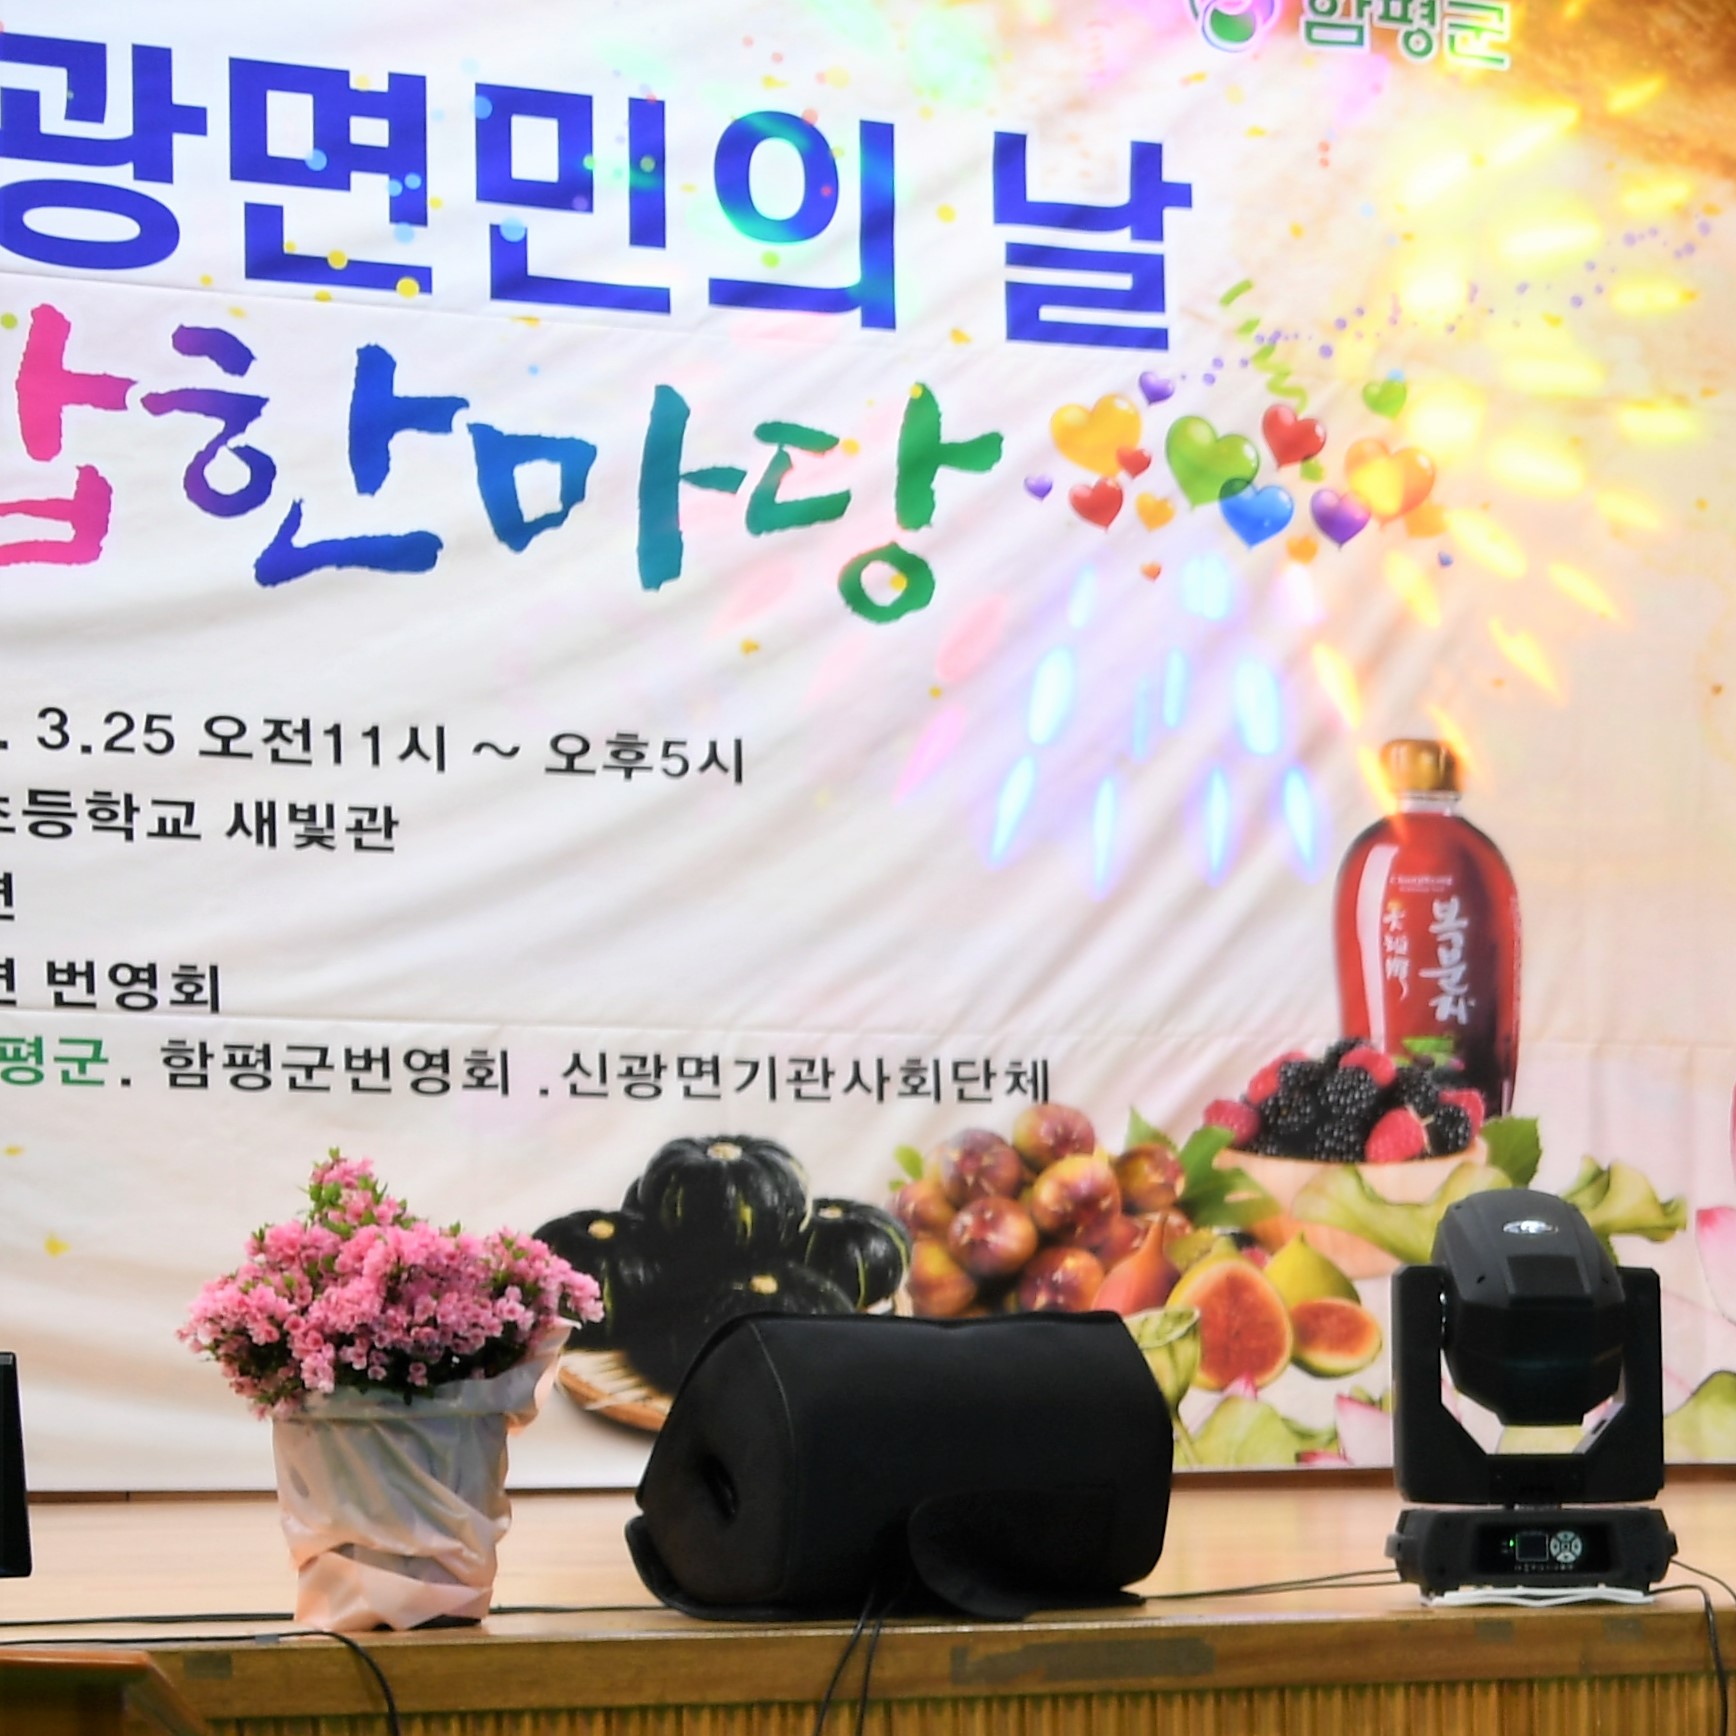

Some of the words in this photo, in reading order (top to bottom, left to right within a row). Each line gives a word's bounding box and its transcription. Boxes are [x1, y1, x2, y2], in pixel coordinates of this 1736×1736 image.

[992, 130, 1193, 352] 날
[35, 706, 177, 758] 3.25
[197, 713, 450, 776] 오전11시
[543, 728, 747, 786] 오후5시
[0, 788, 202, 842] 등학교
[224, 797, 400, 855] 새빛관
[46, 958, 221, 1015] 번영회
[160, 1036, 513, 1101] 함평군번영회
